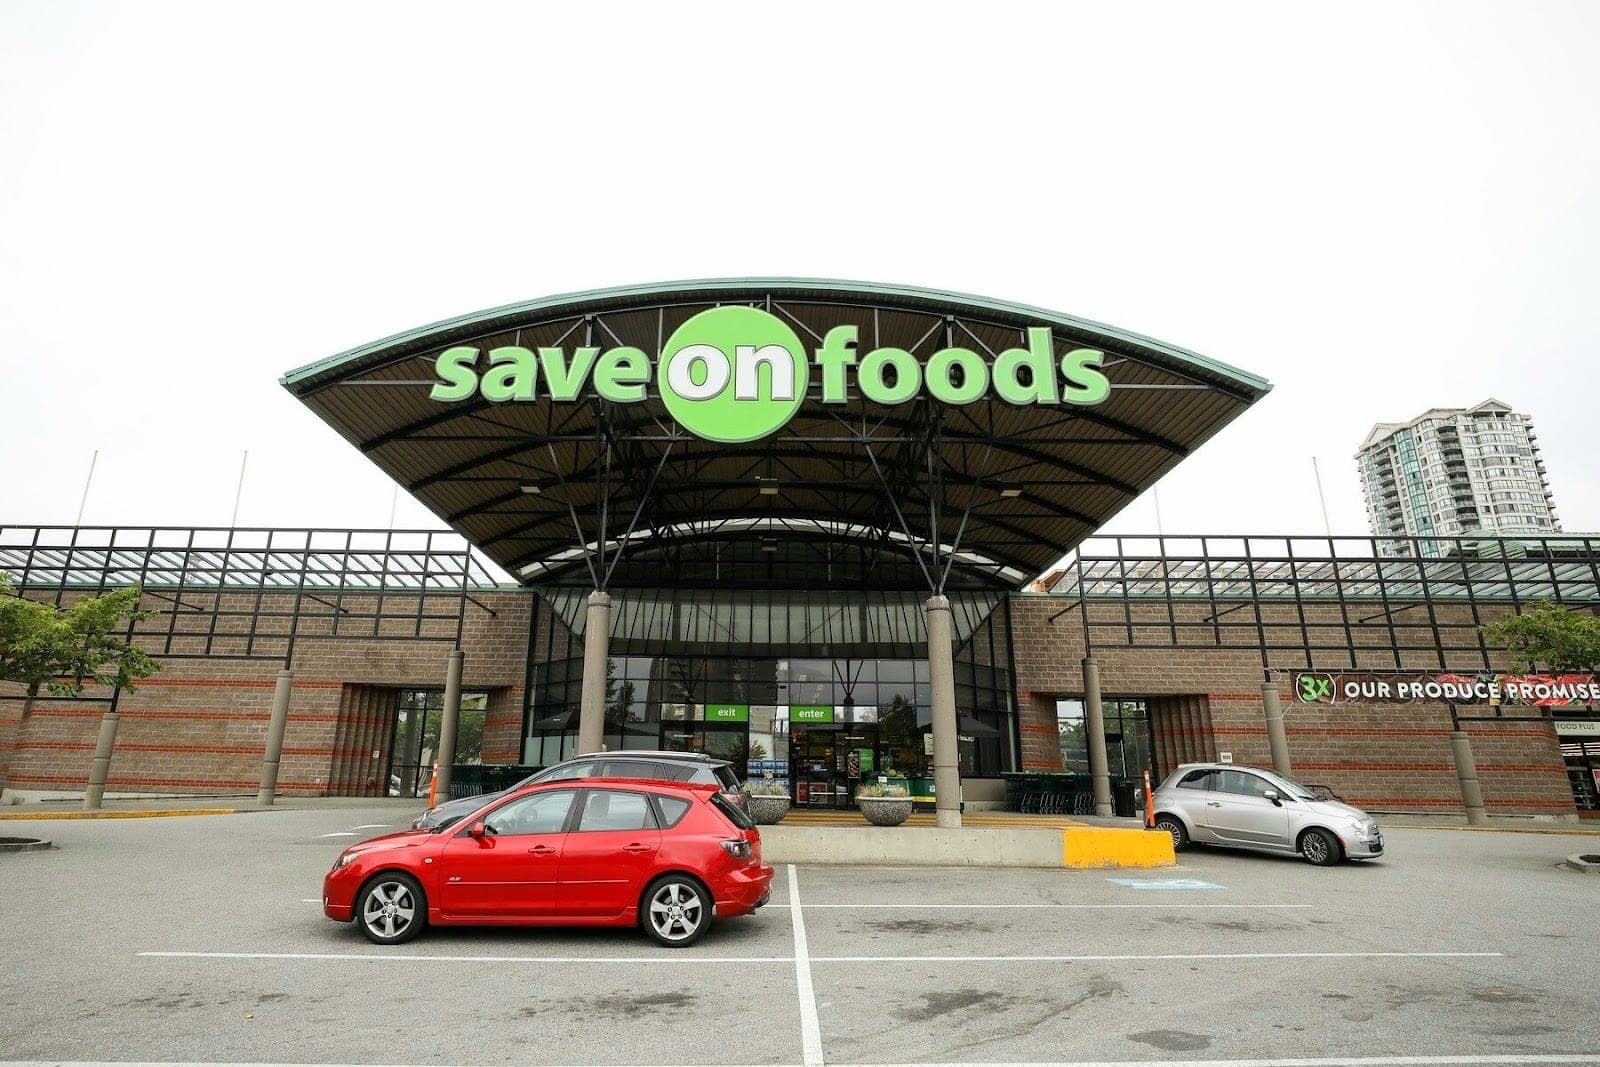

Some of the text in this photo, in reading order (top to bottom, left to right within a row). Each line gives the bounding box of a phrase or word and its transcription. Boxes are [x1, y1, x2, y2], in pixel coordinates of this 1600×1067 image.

[430, 325, 1111, 406] save on foods
[1344, 681, 1391, 698] OUR
[1397, 681, 1501, 699] PRODUCE
[1506, 683, 1600, 700] PROMISE
[717, 707, 736, 716] exit
[798, 710, 825, 719] enter
